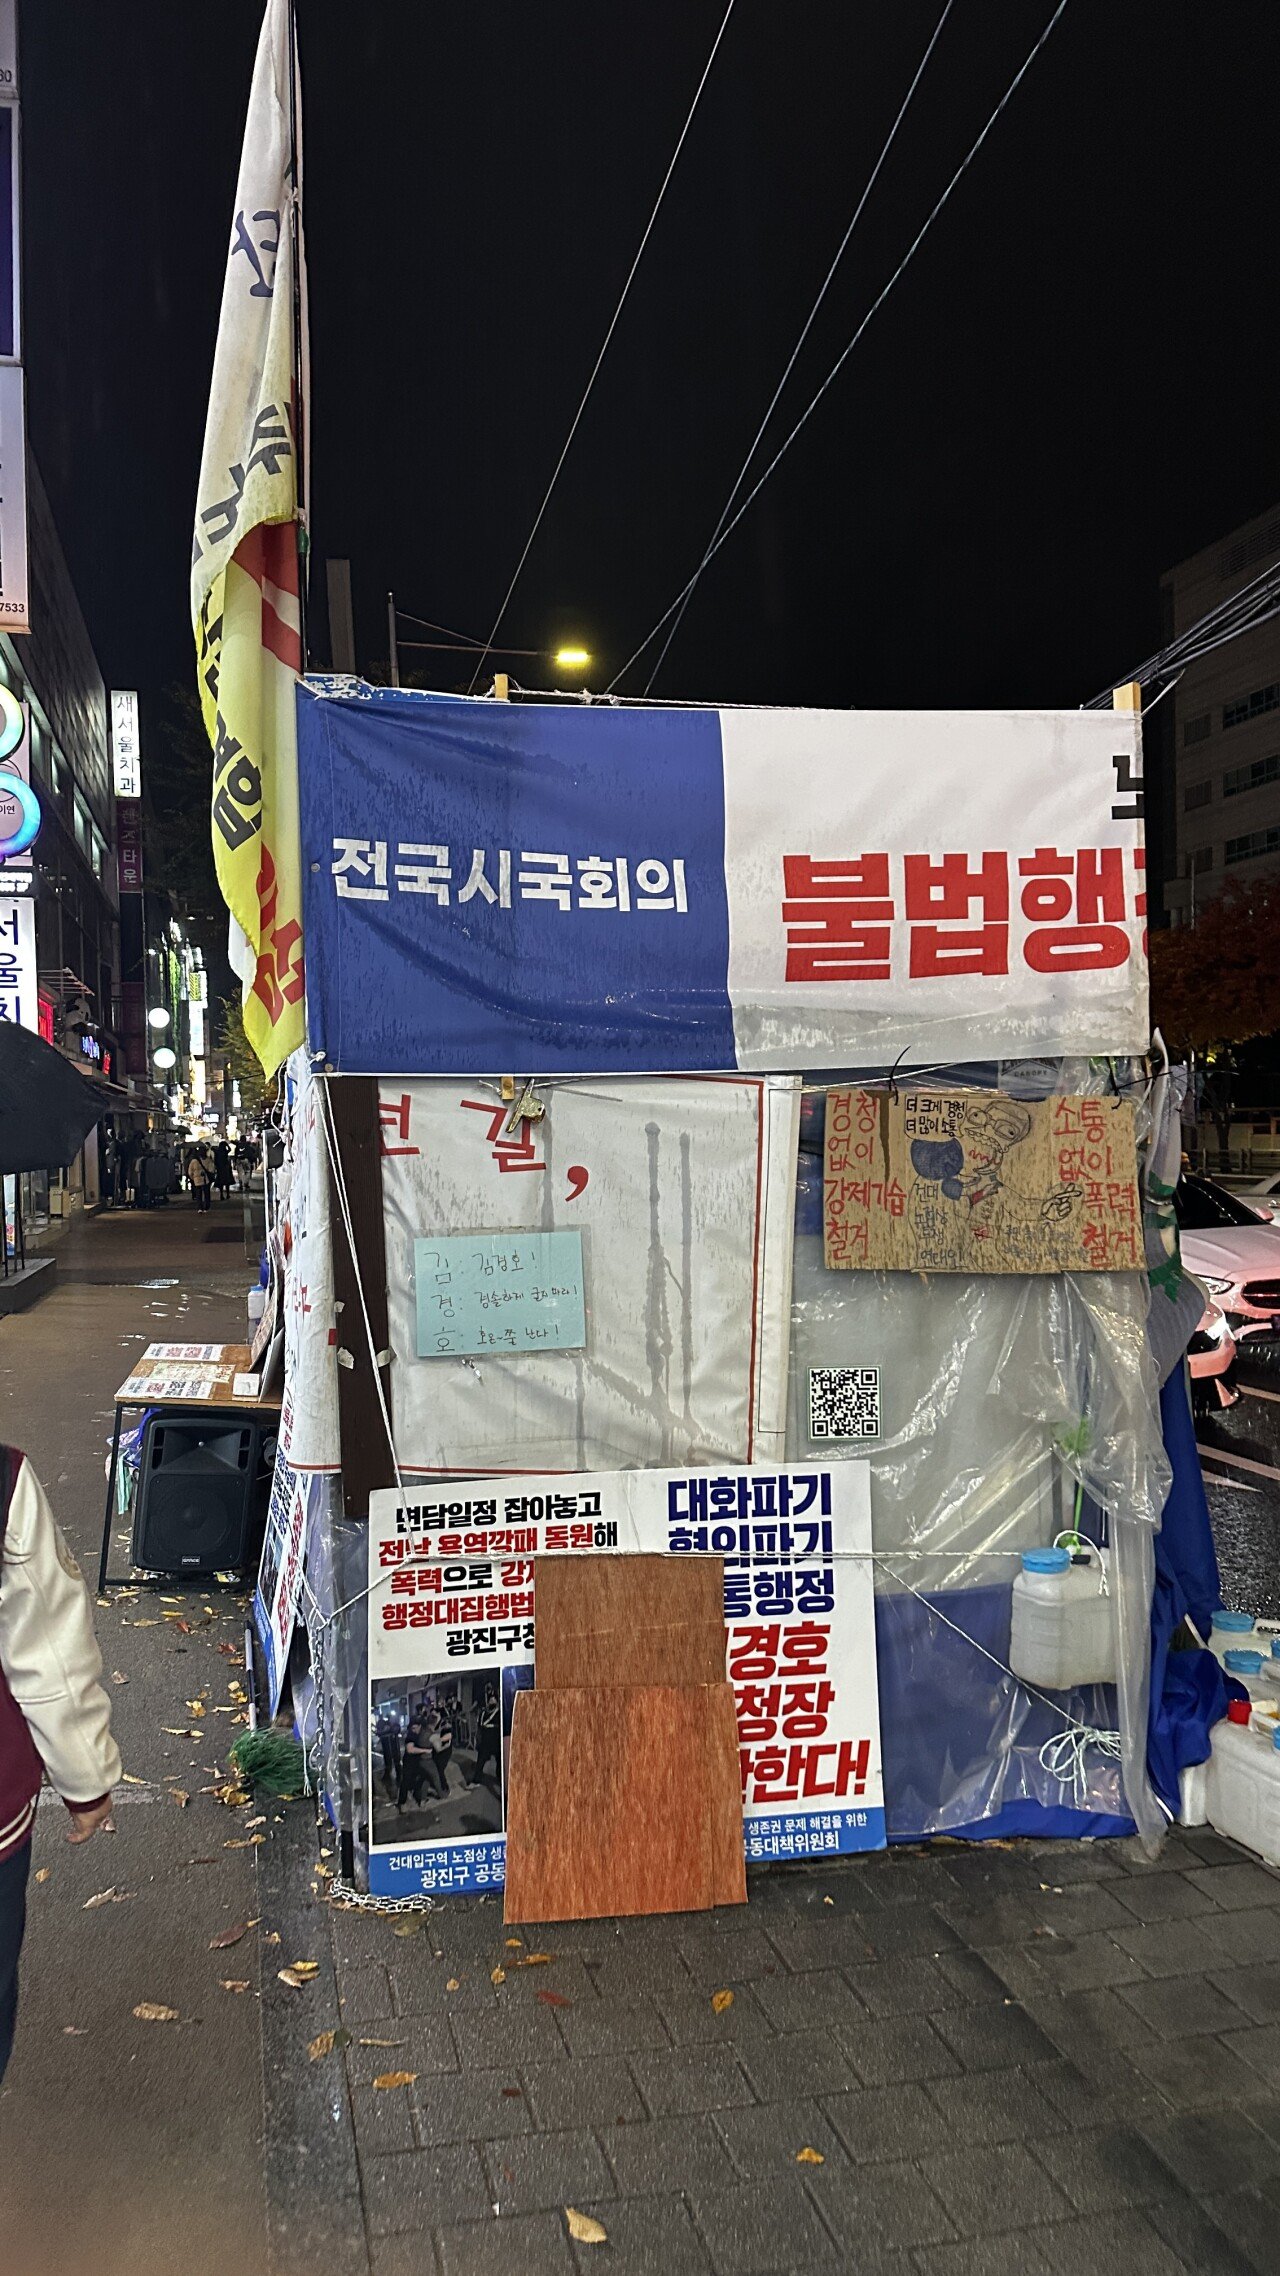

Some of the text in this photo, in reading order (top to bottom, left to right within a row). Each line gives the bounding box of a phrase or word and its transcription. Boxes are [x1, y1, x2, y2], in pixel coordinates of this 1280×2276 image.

[117, 694, 137, 794] 새서울치과
[331, 837, 689, 914] 전국시국회의
[782, 847, 1150, 983] 불법행
[828, 1091, 877, 1133] 경청
[906, 1096, 917, 1113] 더
[906, 1117, 917, 1134] 더
[919, 1115, 939, 1134] 많이
[1053, 1097, 1107, 1143] 소통
[827, 1133, 876, 1172] 없이
[1058, 1145, 1112, 1181] 없이
[1084, 1182, 1136, 1223] 폭력
[826, 1216, 869, 1261] 철거
[1082, 1221, 1137, 1269] 철거
[396, 1492, 602, 1533] 면담일정 잡아놓고
[668, 1473, 832, 1522] 대화파기
[545, 1521, 618, 1549] 동원해
[391, 1563, 493, 1596] 폭력으로
[725, 1620, 831, 1681] 경호
[748, 1812, 868, 1836] 생존권 문제 해결을 위한
[389, 1853, 448, 1871] 건대입구역
[452, 1848, 487, 1864] 노점상
[420, 1866, 471, 1889] 광진구
